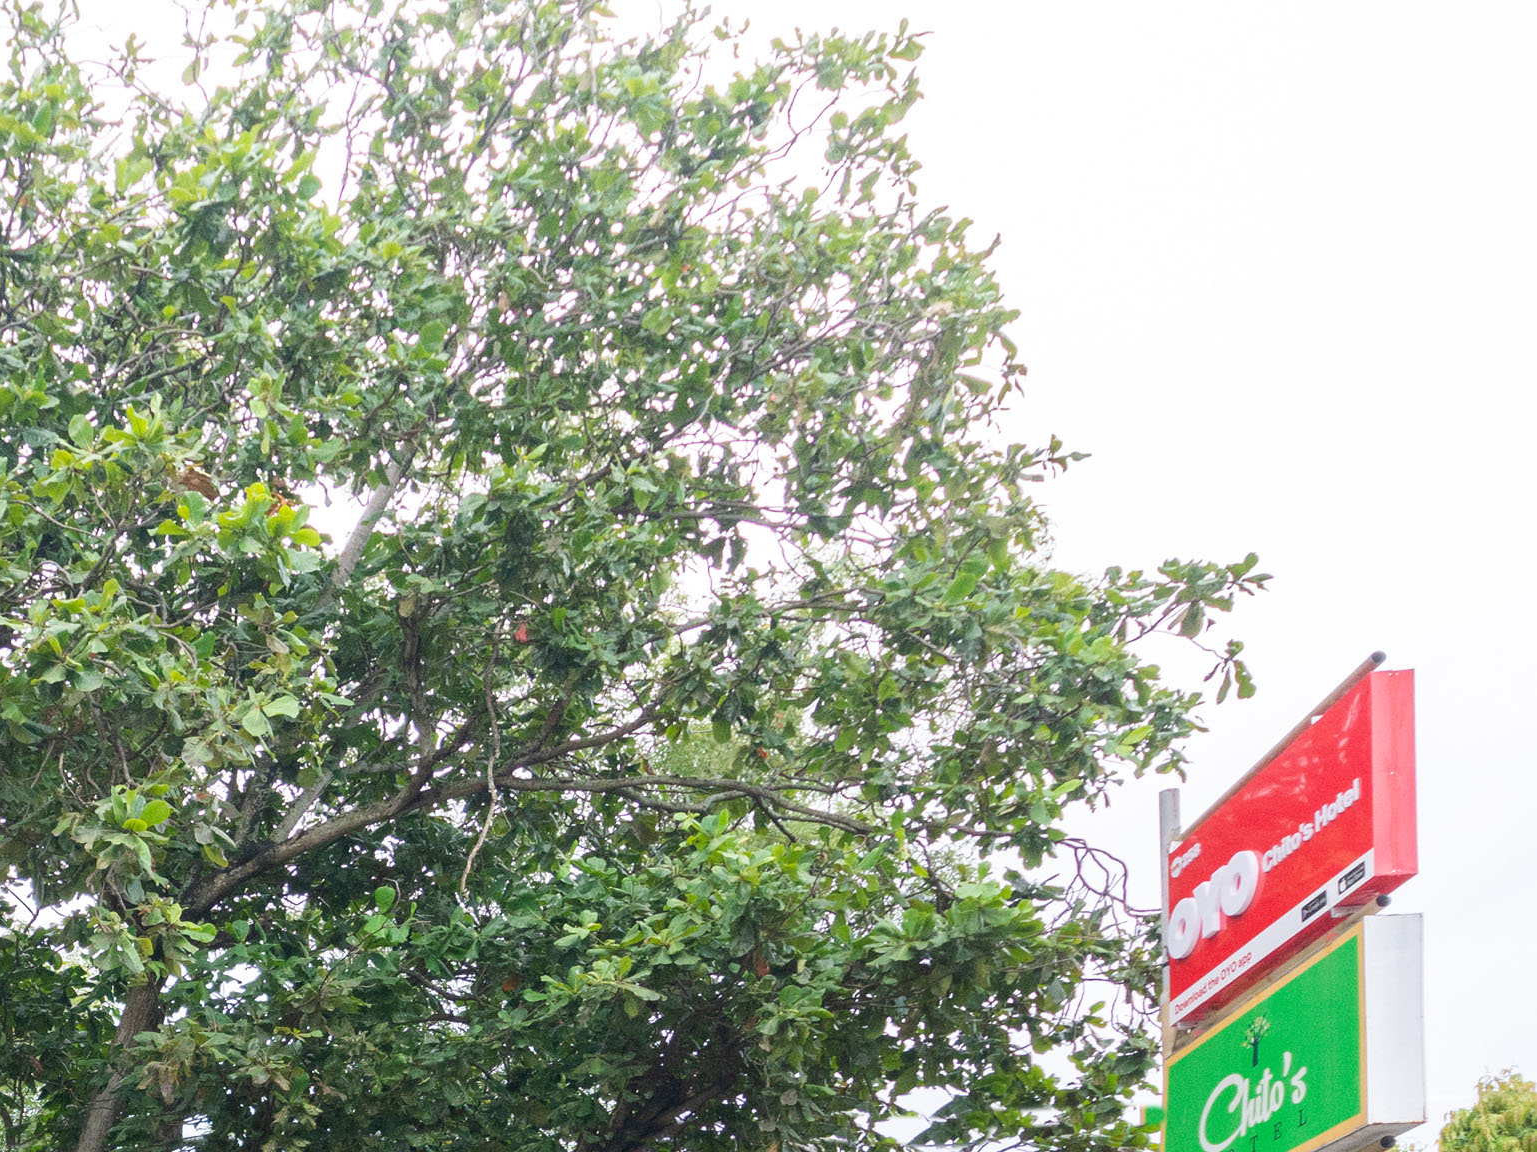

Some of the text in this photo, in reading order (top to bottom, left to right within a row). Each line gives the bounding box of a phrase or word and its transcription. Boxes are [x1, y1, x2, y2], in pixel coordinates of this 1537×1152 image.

[1167, 850, 1259, 960] OYO
[1262, 823, 1314, 873] Chito's
[1314, 778, 1360, 832] Hotel
[1174, 951, 1252, 1015] Download the OYO app
